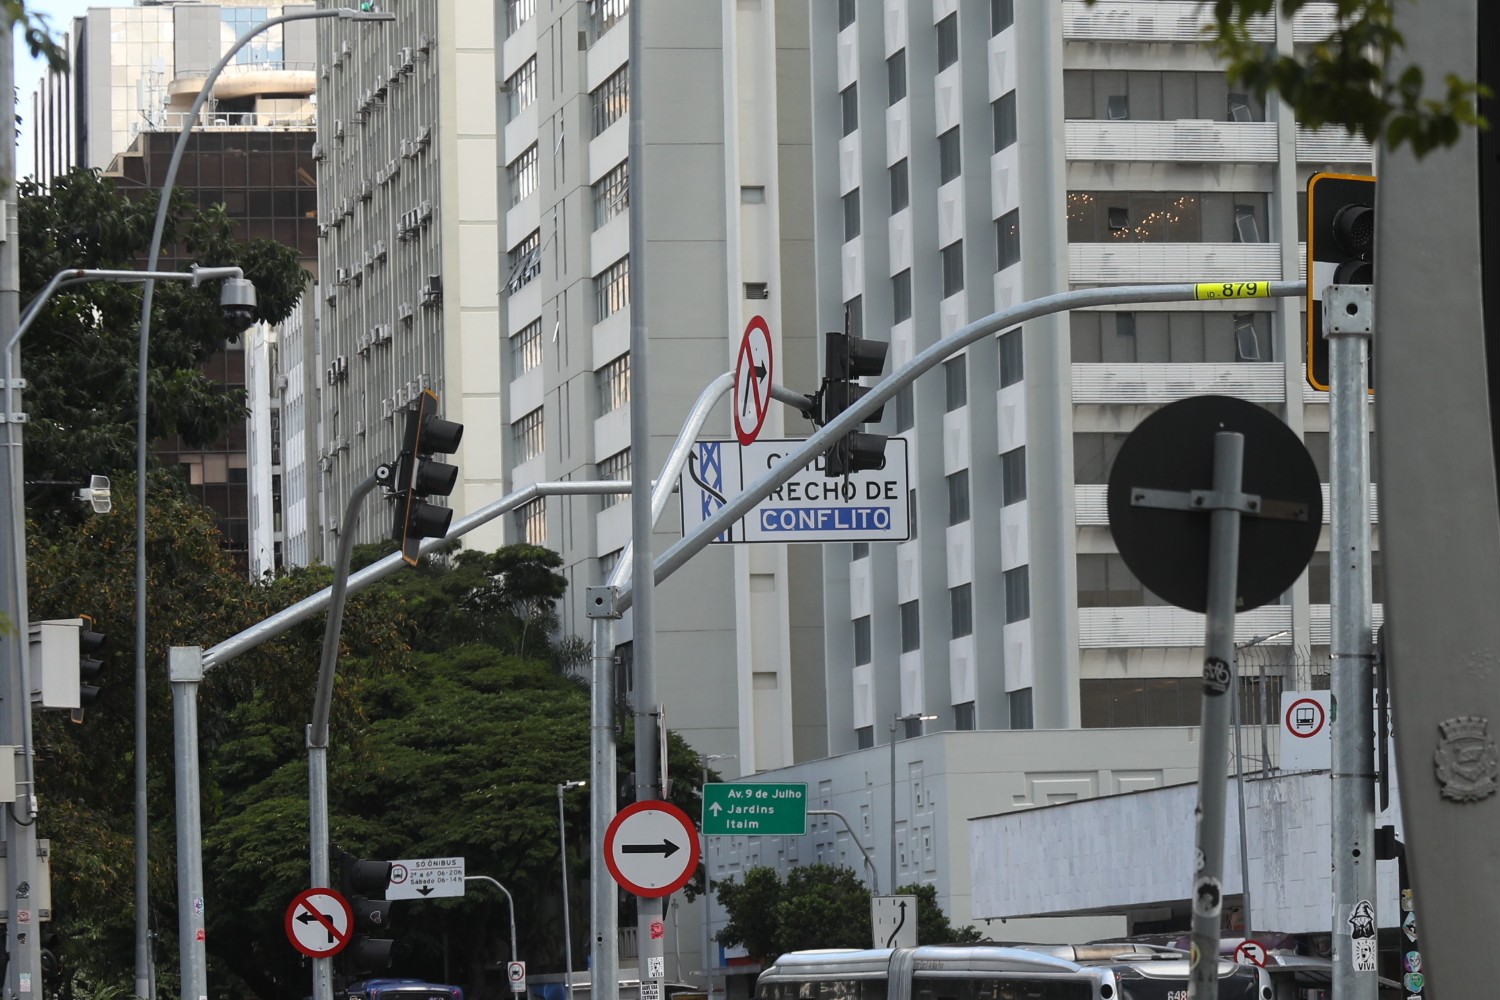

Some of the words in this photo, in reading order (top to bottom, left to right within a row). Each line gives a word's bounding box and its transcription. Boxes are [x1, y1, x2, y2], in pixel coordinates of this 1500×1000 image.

[1222, 282, 1258, 297] 879
[768, 481, 857, 501] RECHO
[866, 481, 898, 501] DE
[762, 508, 890, 530] CONFLITO
[728, 789, 744, 799] Av.
[745, 789, 752, 798] 9
[755, 789, 768, 798] de
[772, 789, 802, 799] Julho
[727, 804, 775, 814] Jardins
[726, 819, 759, 829] Itaim
[416, 860, 426, 868] SÓ
[427, 859, 457, 867] ÔNIBUS
